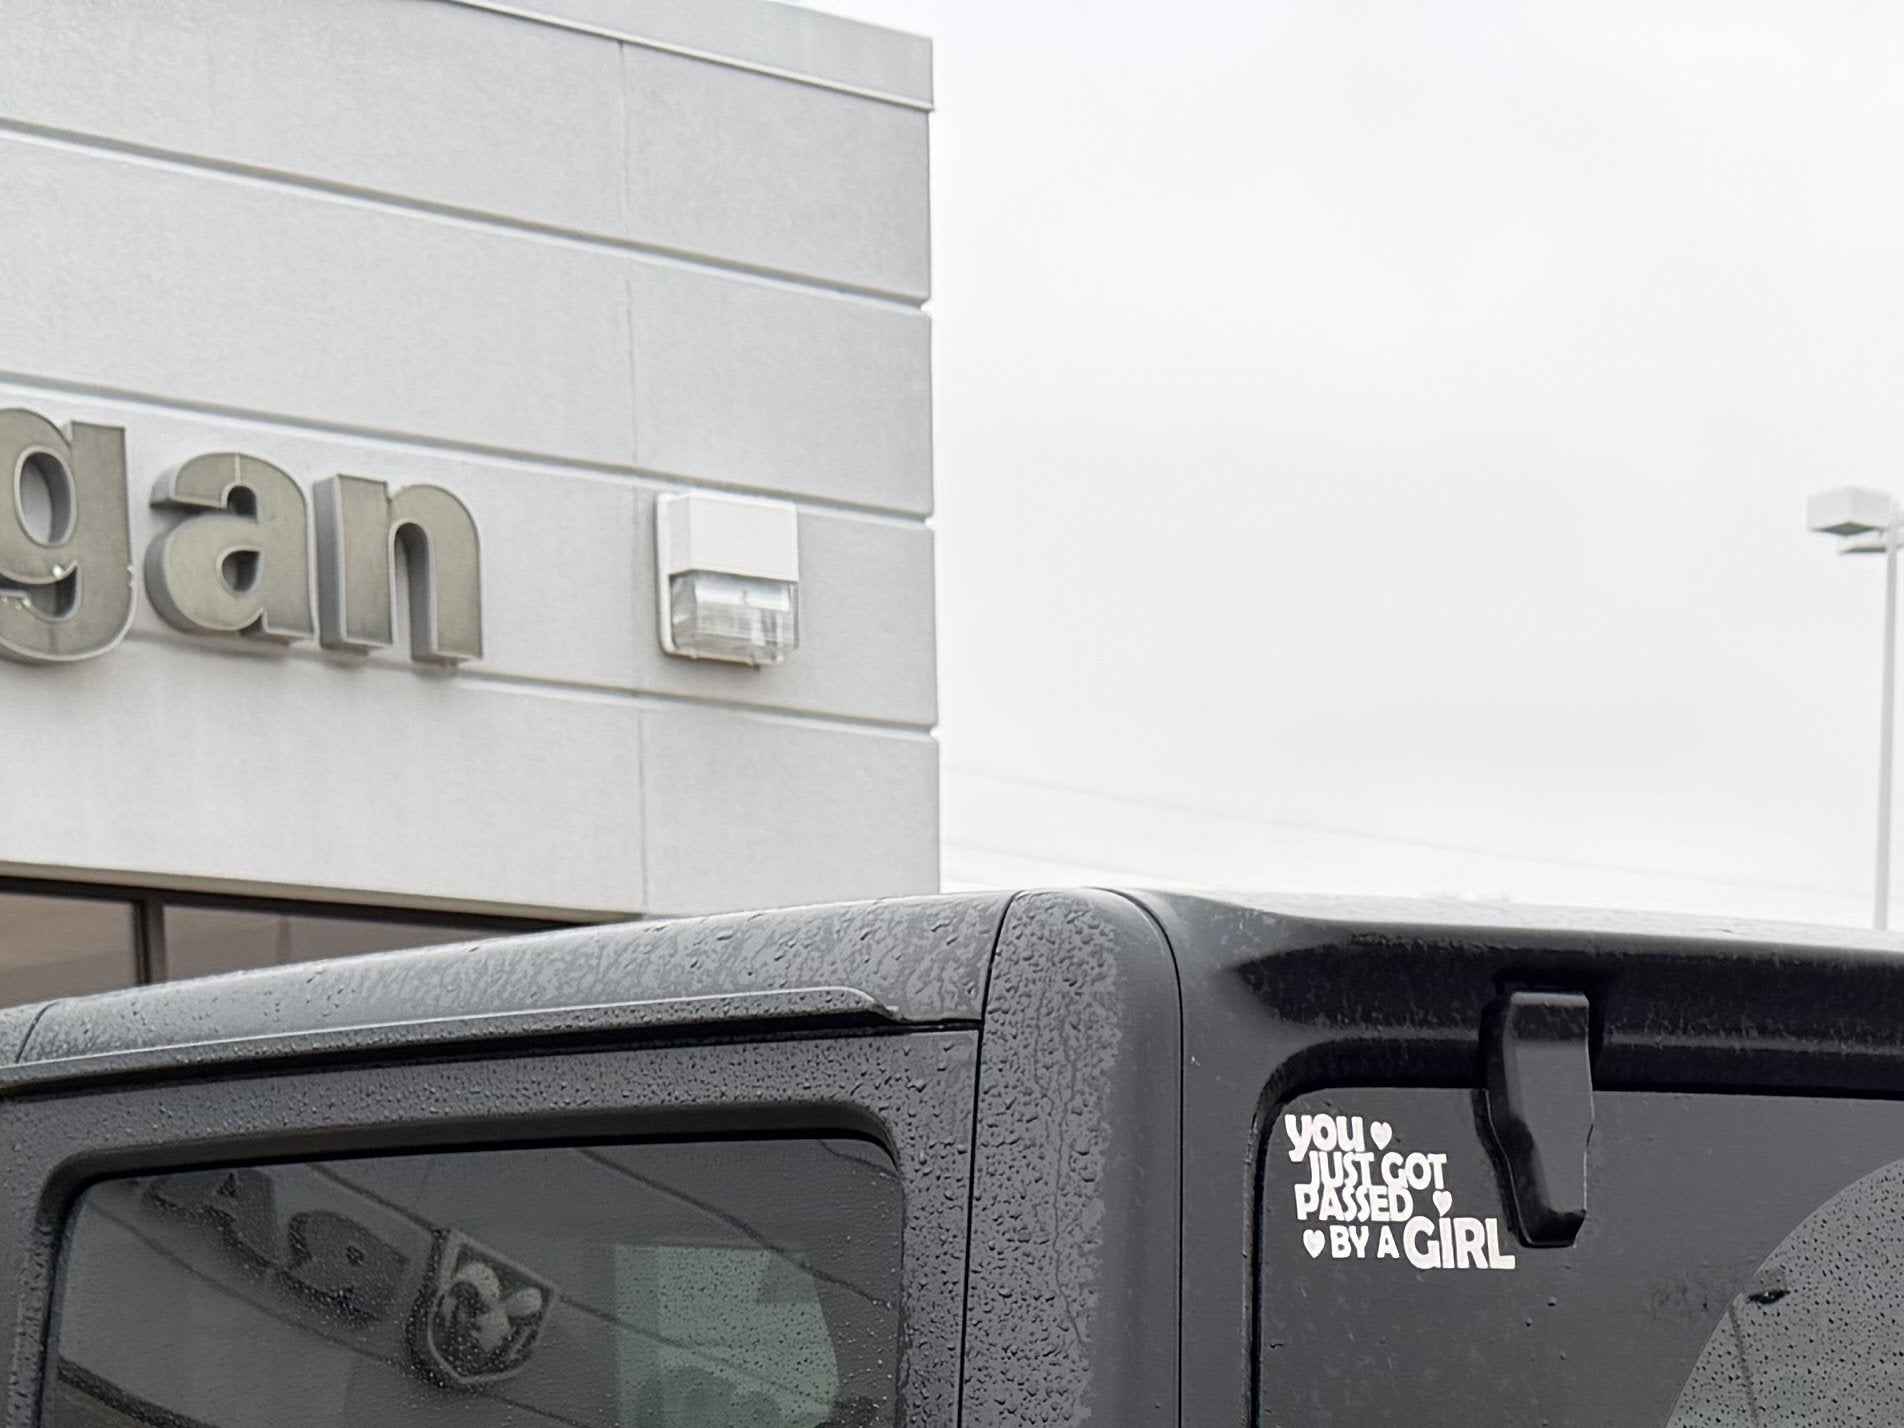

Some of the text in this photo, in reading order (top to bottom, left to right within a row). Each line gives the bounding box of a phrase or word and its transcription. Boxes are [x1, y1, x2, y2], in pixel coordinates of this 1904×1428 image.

[1307, 1150, 1448, 1190] JUST GOT
[1294, 1183, 1414, 1223] PASSED
[1329, 1215, 1516, 1270] BY A GIRL
